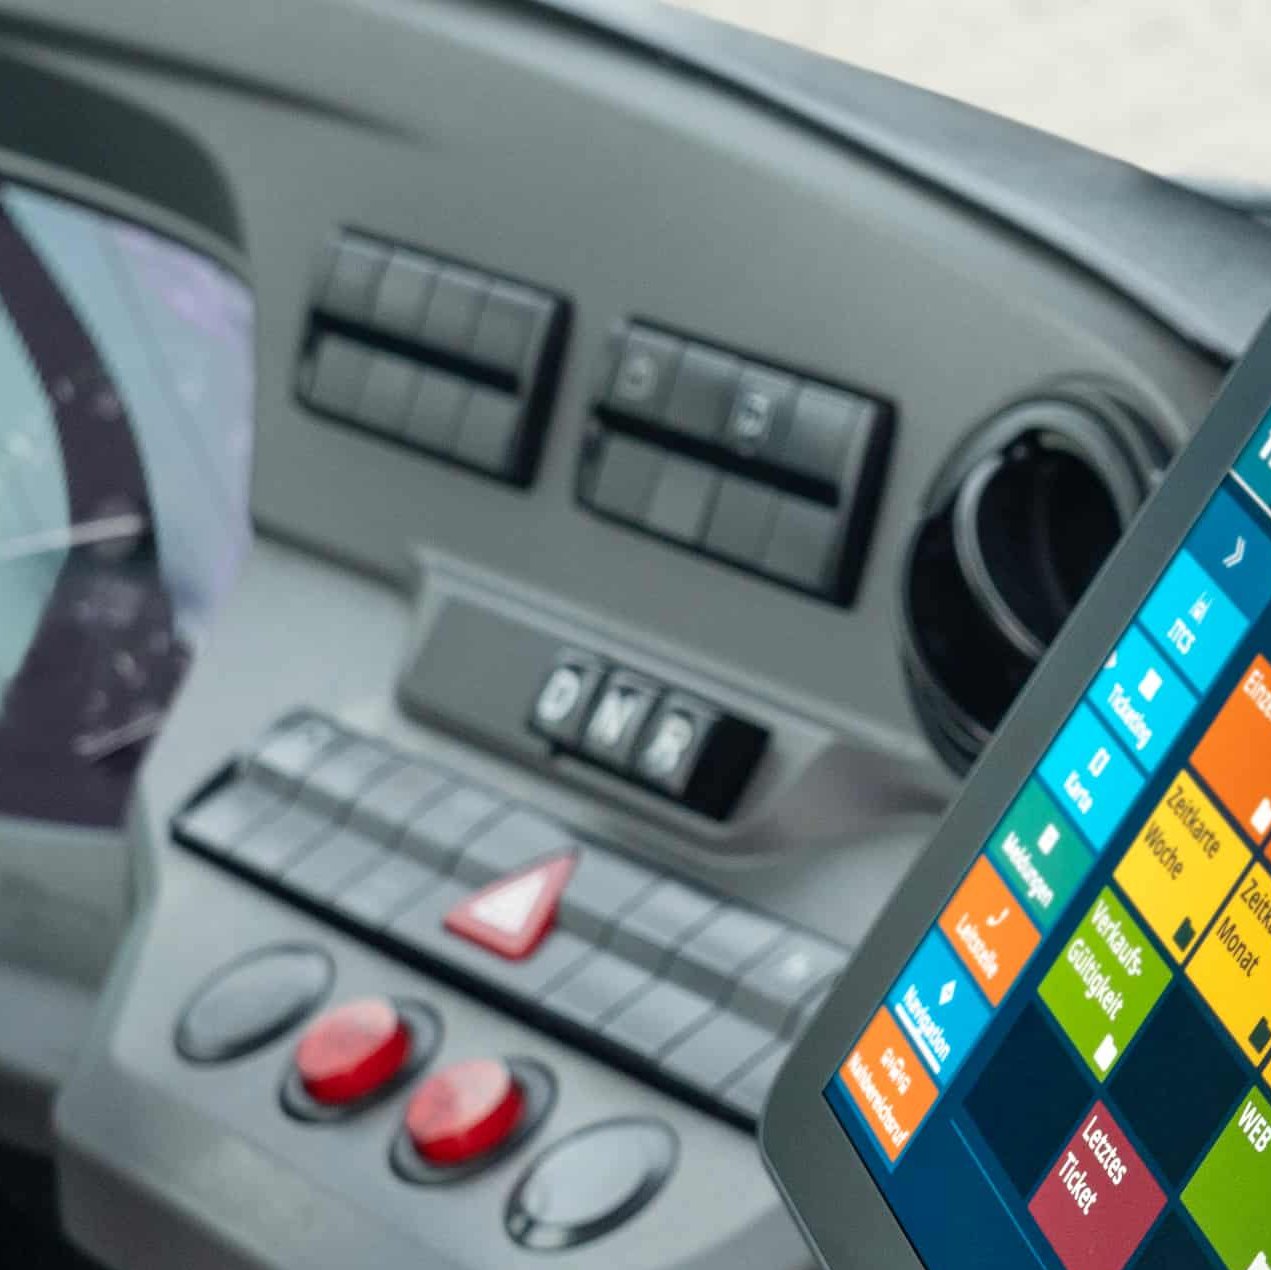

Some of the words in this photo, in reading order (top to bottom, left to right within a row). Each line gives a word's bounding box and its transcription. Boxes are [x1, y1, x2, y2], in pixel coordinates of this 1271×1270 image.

[1144, 822, 1183, 880] Woche
[1167, 786, 1220, 859] Zeitkarte
[1092, 900, 1141, 976] Verkaufs-
[1217, 916, 1259, 977] Monat
[1067, 938, 1123, 1020] Gültigkeit
[1059, 1152, 1097, 1215] Ticket
[1082, 1116, 1126, 1185] Letztes
